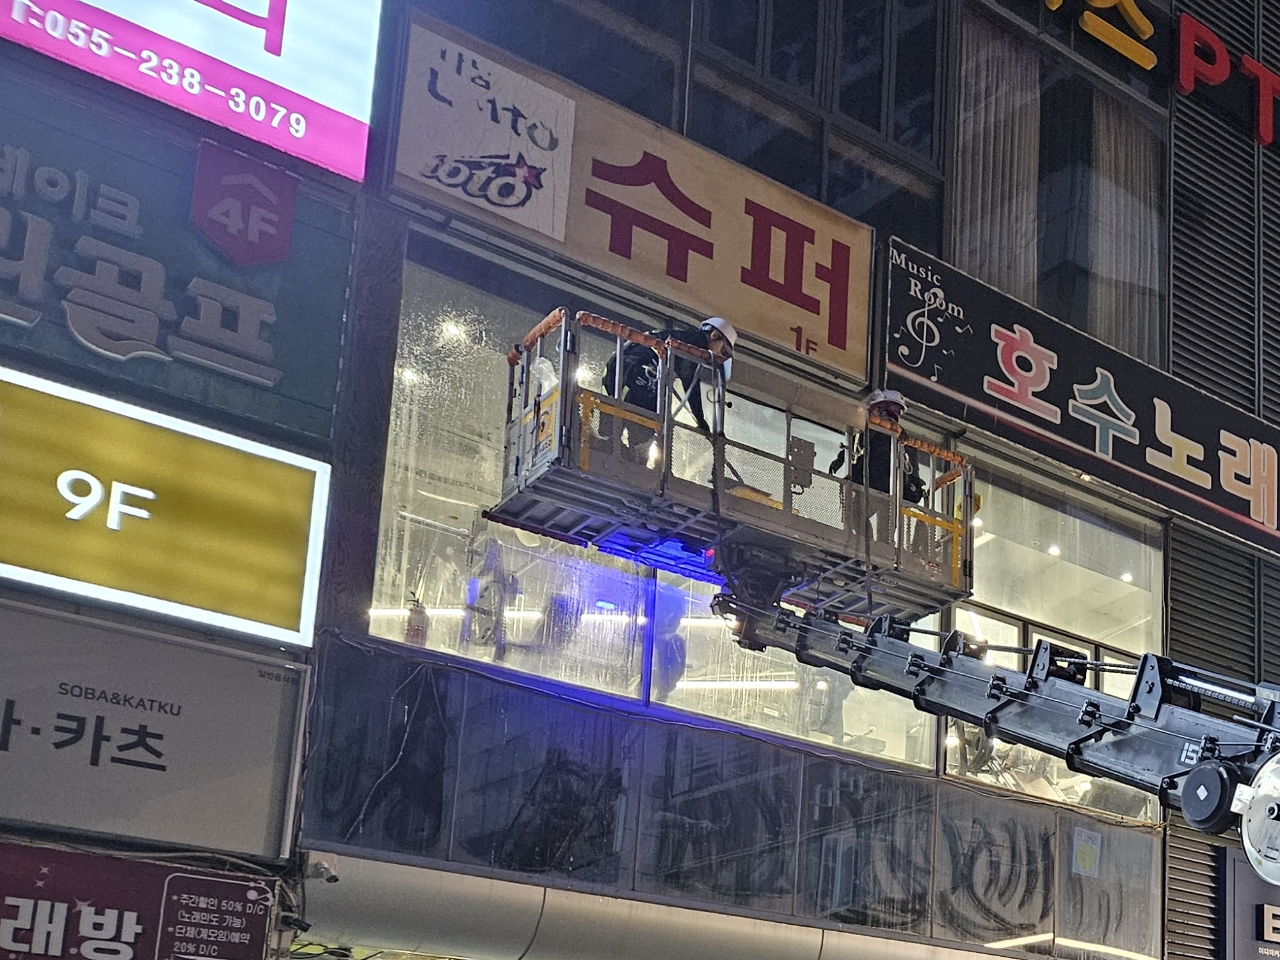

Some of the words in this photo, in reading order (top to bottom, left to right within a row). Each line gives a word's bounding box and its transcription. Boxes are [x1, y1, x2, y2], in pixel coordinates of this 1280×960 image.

[207, 196, 280, 244] 4F
[584, 150, 851, 351] 슈퍼
[890, 246, 942, 286] Music
[908, 277, 965, 320] Room
[790, 325, 818, 355] 1F
[56, 468, 157, 531] 9F
[57, 682, 181, 717] SOBA&KATKU
[221, 900, 243, 912] 50%
[246, 903, 265, 915] D/C
[173, 941, 196, 953] 20%
[199, 944, 218, 956] D/C
